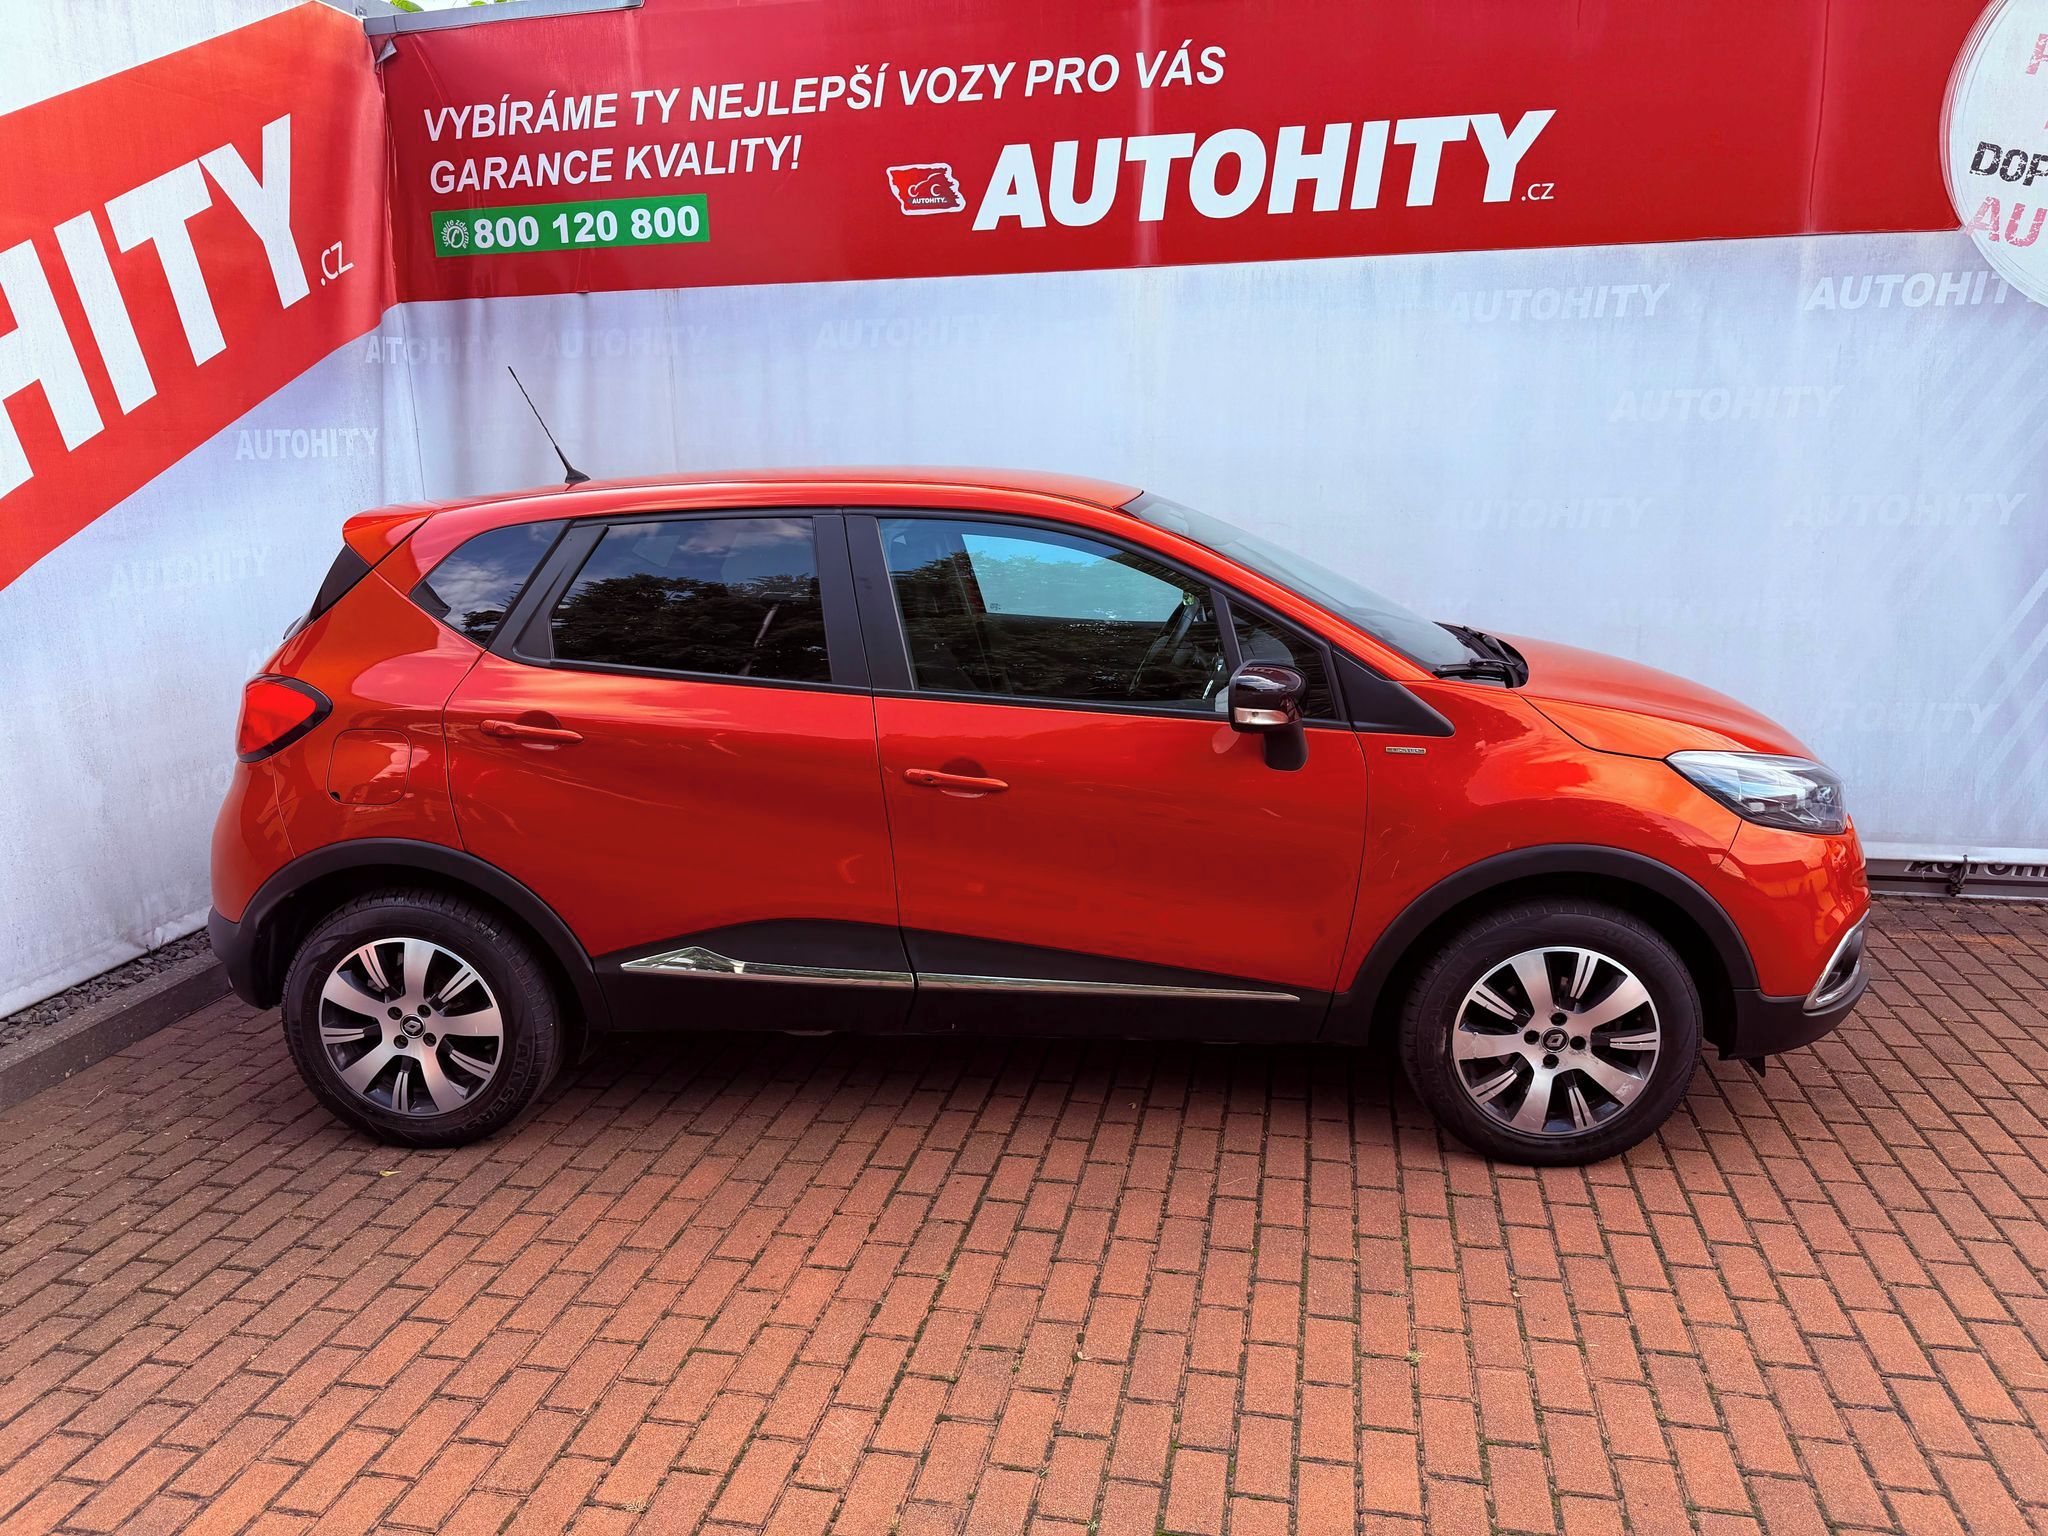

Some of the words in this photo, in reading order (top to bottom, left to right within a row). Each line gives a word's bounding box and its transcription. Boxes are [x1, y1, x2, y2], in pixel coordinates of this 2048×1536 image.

[424, 90, 618, 142] VYBÍRÁME
[631, 88, 680, 126] TY
[689, 63, 888, 122] NEJLEPŠÍ
[899, 62, 1016, 106] VOZY
[1024, 54, 1120, 97] PRO
[1135, 39, 1226, 89] VÁS
[430, 148, 614, 195] GARANCE
[625, 134, 802, 181] KVALITY!
[972, 109, 1557, 231] AUTOHITY
[911, 197, 945, 205] AUTOHITY
[473, 215, 540, 249] 800
[552, 210, 618, 244] 120
[630, 205, 700, 240] 800
[1446, 283, 1669, 323] AUTOHITY
[812, 313, 999, 353] AUTOHITY
[1608, 384, 1844, 424] AUTOHITY
[234, 427, 379, 462] AUTOHITY
